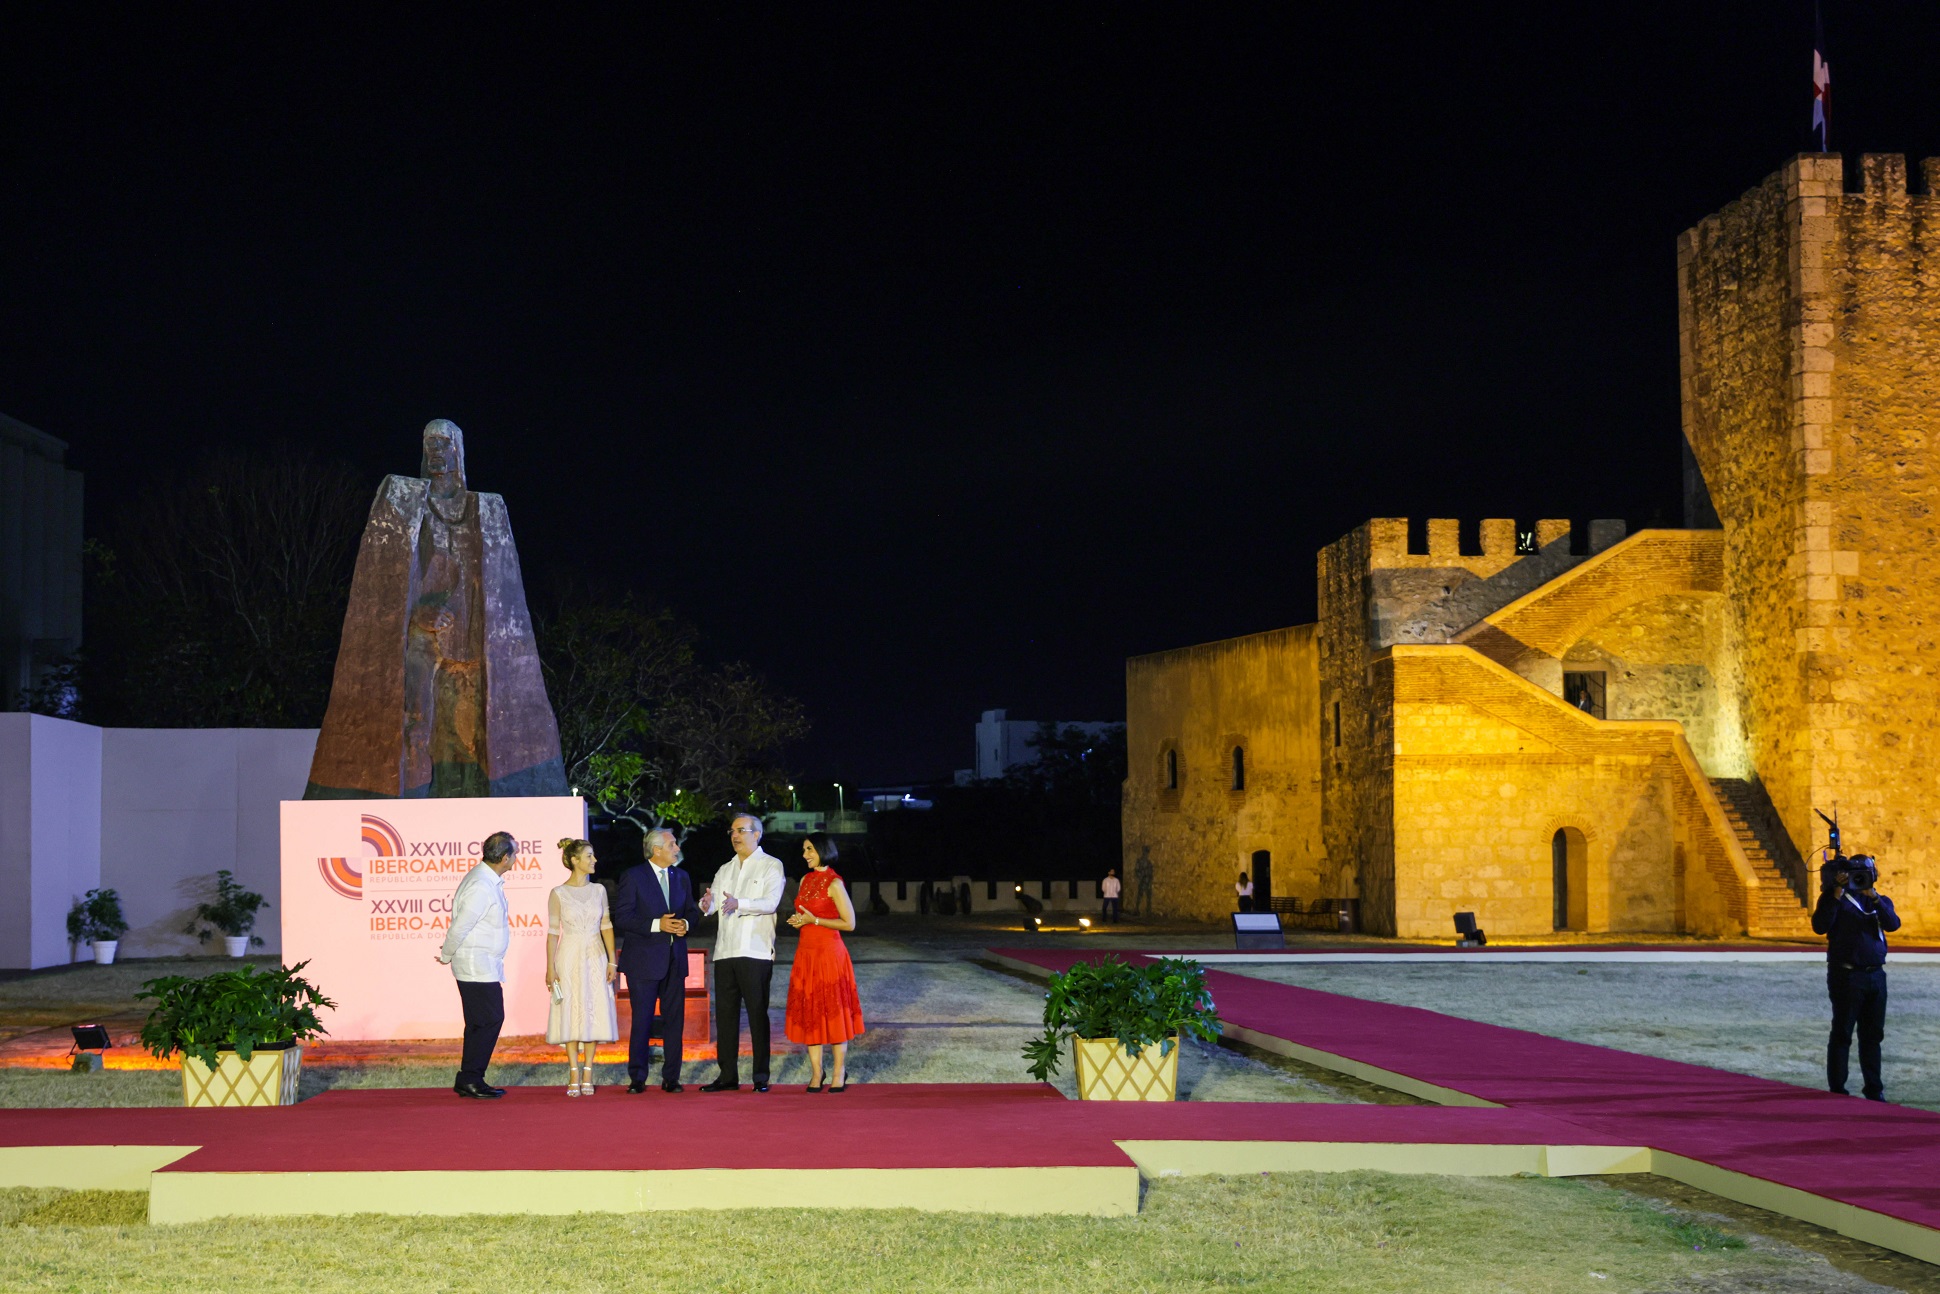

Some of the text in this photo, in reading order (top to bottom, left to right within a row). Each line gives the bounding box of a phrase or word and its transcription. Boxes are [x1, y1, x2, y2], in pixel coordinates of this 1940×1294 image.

[410, 842, 461, 857] XXVIII
[369, 875, 422, 883] REPÚBLICA
[371, 899, 423, 914] XXVIII
[370, 932, 423, 941] REPÚBLICA
